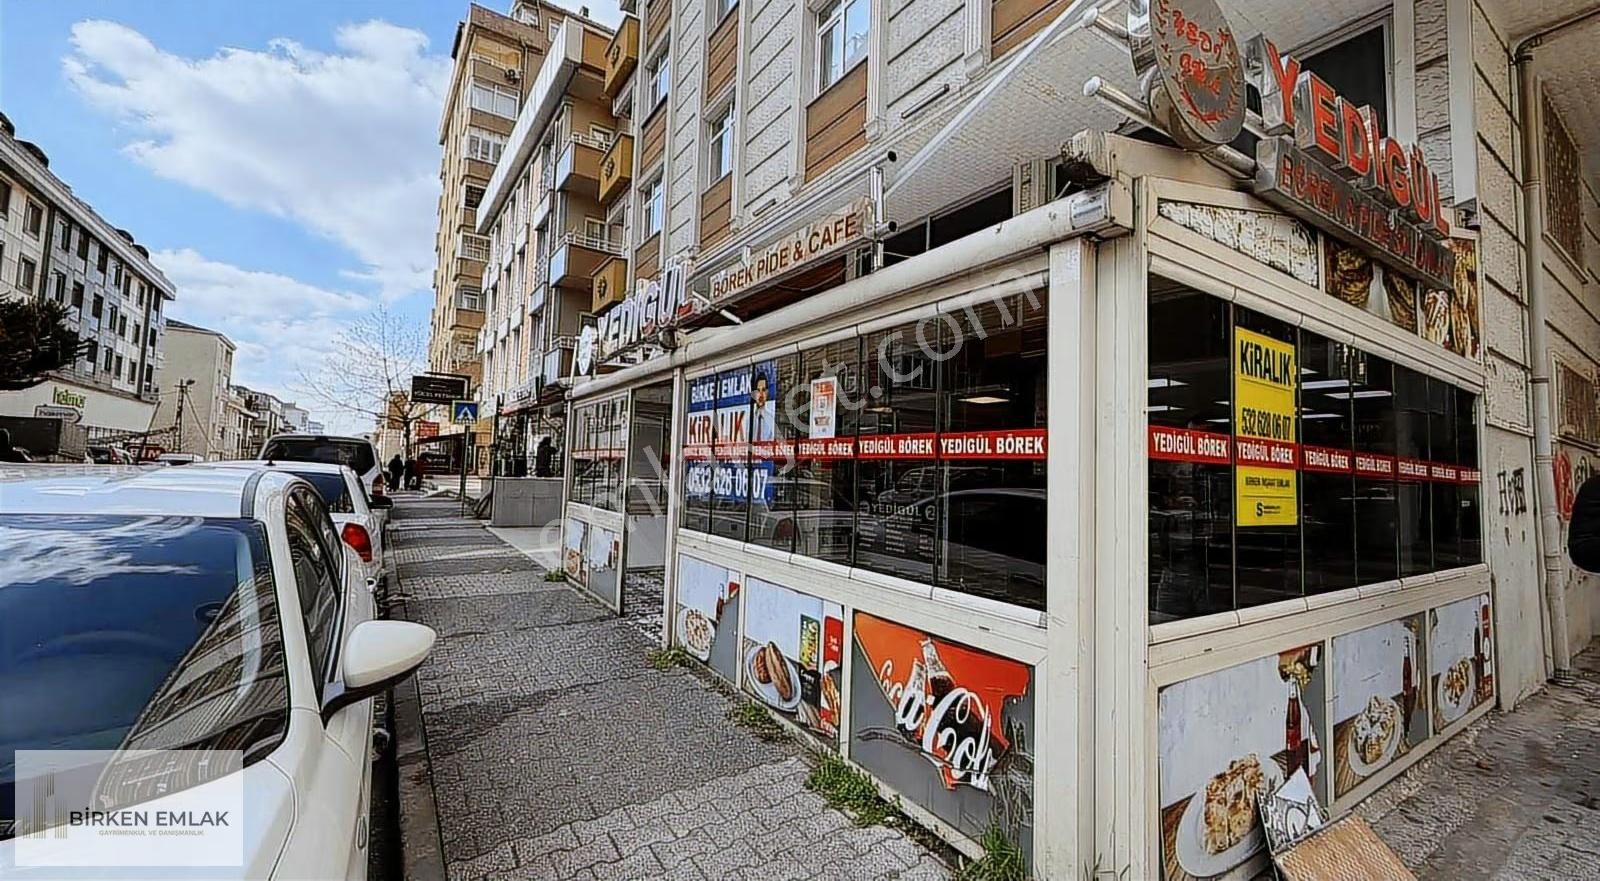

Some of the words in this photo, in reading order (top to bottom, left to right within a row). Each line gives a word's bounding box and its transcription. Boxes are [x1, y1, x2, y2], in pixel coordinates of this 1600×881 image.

[1250, 33, 1450, 240] YEDİGÜL
[757, 246, 789, 279] PİDE
[793, 241, 804, 262] &
[809, 213, 857, 254] CAFE
[691, 376, 720, 404] BİRKE
[722, 373, 753, 398] EMLAK
[1241, 407, 1257, 436] 532
[859, 437, 896, 454] YEDİGÜL
[899, 437, 933, 454] BÖREK
[940, 435, 992, 454] YEDİGÜL
[996, 434, 1044, 454] BÖREK
[1153, 432, 1196, 455] YEDİGÜL
[1197, 434, 1228, 458] BÖREK
[1237, 440, 1269, 461] YEDİGÜL
[1270, 444, 1294, 464] BÖREK
[752, 468, 768, 499] 07
